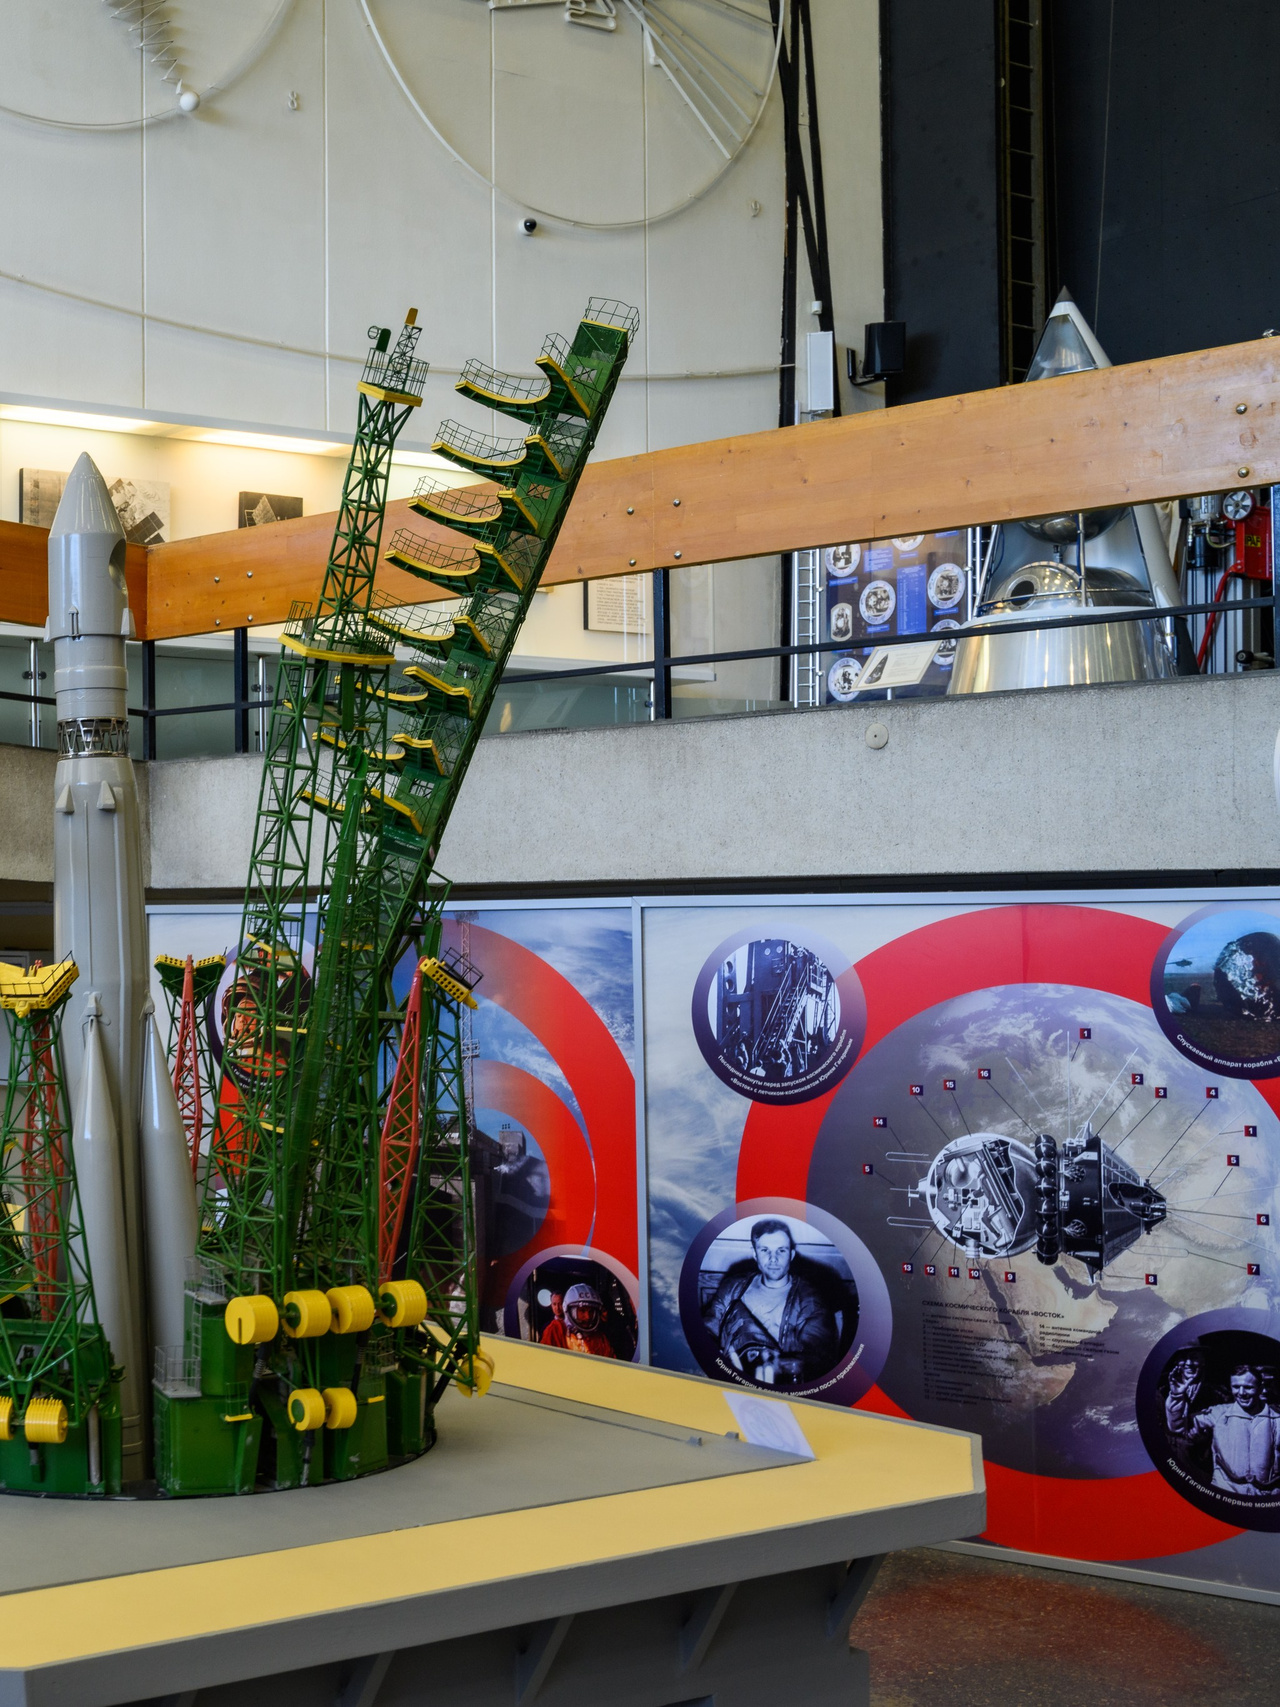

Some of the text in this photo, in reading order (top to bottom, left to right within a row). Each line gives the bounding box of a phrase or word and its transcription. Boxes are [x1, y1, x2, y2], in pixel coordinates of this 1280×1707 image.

[718, 1055, 742, 1077] Последние
[743, 1074, 763, 1085] минуты
[781, 1077, 806, 1087] запуском
[806, 1052, 836, 1080] космического
[835, 1029, 846, 1052] корабля
[730, 1077, 753, 1091] «Восток»
[819, 1066, 837, 1082] Юрием
[834, 1038, 853, 1068] Гагариным
[1177, 1034, 1273, 1068] Спускаемый аппарат корабля
[945, 1302, 997, 1312] КОСМИЧЕСКОГО
[999, 1307, 1029, 1315] КОРАБЛЯ
[715, 1357, 732, 1374] Юрий
[732, 1370, 758, 1390] Гагарин
[790, 1386, 819, 1396] моменты
[820, 1378, 837, 1390] после
[836, 1343, 864, 1380] приземления
[1167, 1458, 1186, 1478] Юрий
[1185, 1476, 1214, 1497] Гагарин
[1223, 1496, 1253, 1507] первые
